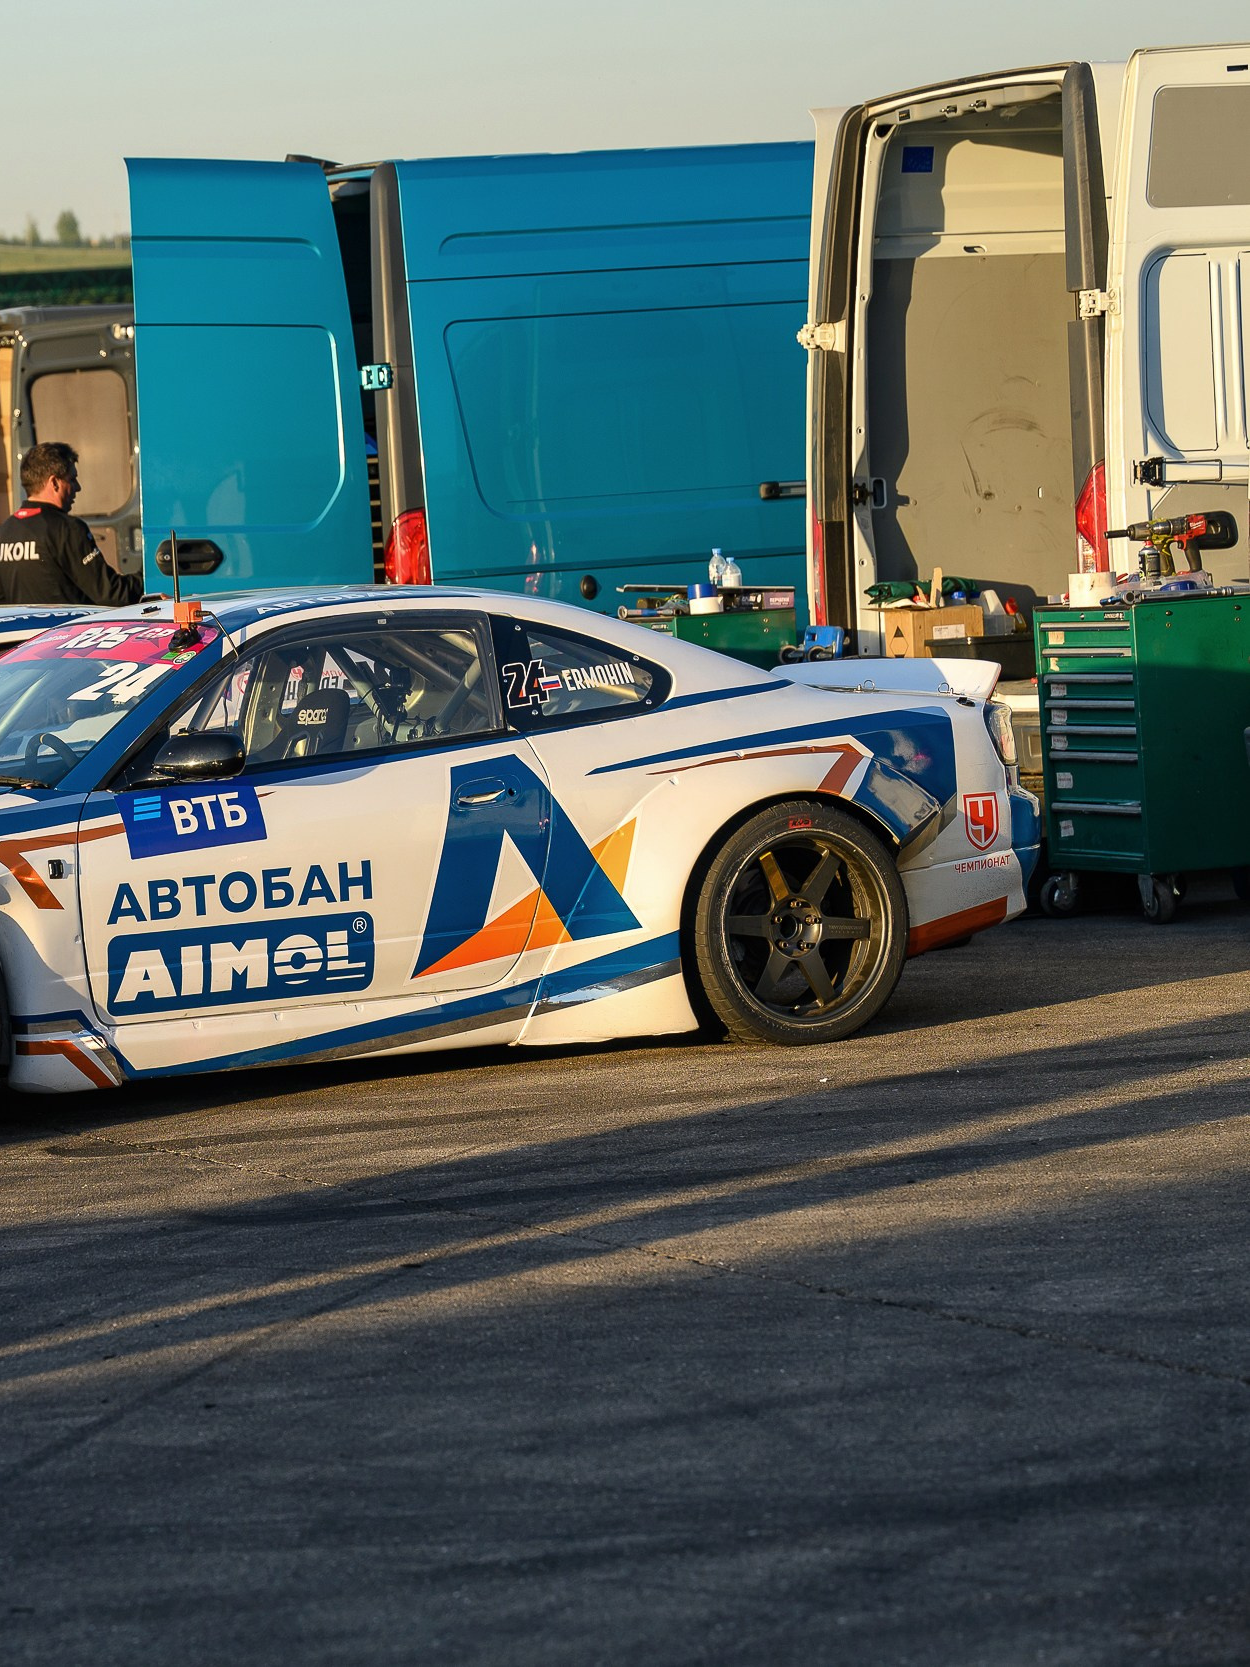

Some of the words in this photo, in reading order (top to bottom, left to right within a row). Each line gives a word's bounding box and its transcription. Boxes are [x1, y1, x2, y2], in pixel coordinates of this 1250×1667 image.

[256, 590, 414, 615] АВТОБАН
[67, 662, 175, 704] 24
[502, 659, 549, 708] 24
[561, 661, 635, 691] ERMOHIN
[168, 791, 248, 836] ВТБ
[954, 855, 1010, 874] ЧЕМПИОНАТ
[106, 859, 374, 926] АВТОБАН
[114, 929, 367, 1004] AIMOL
